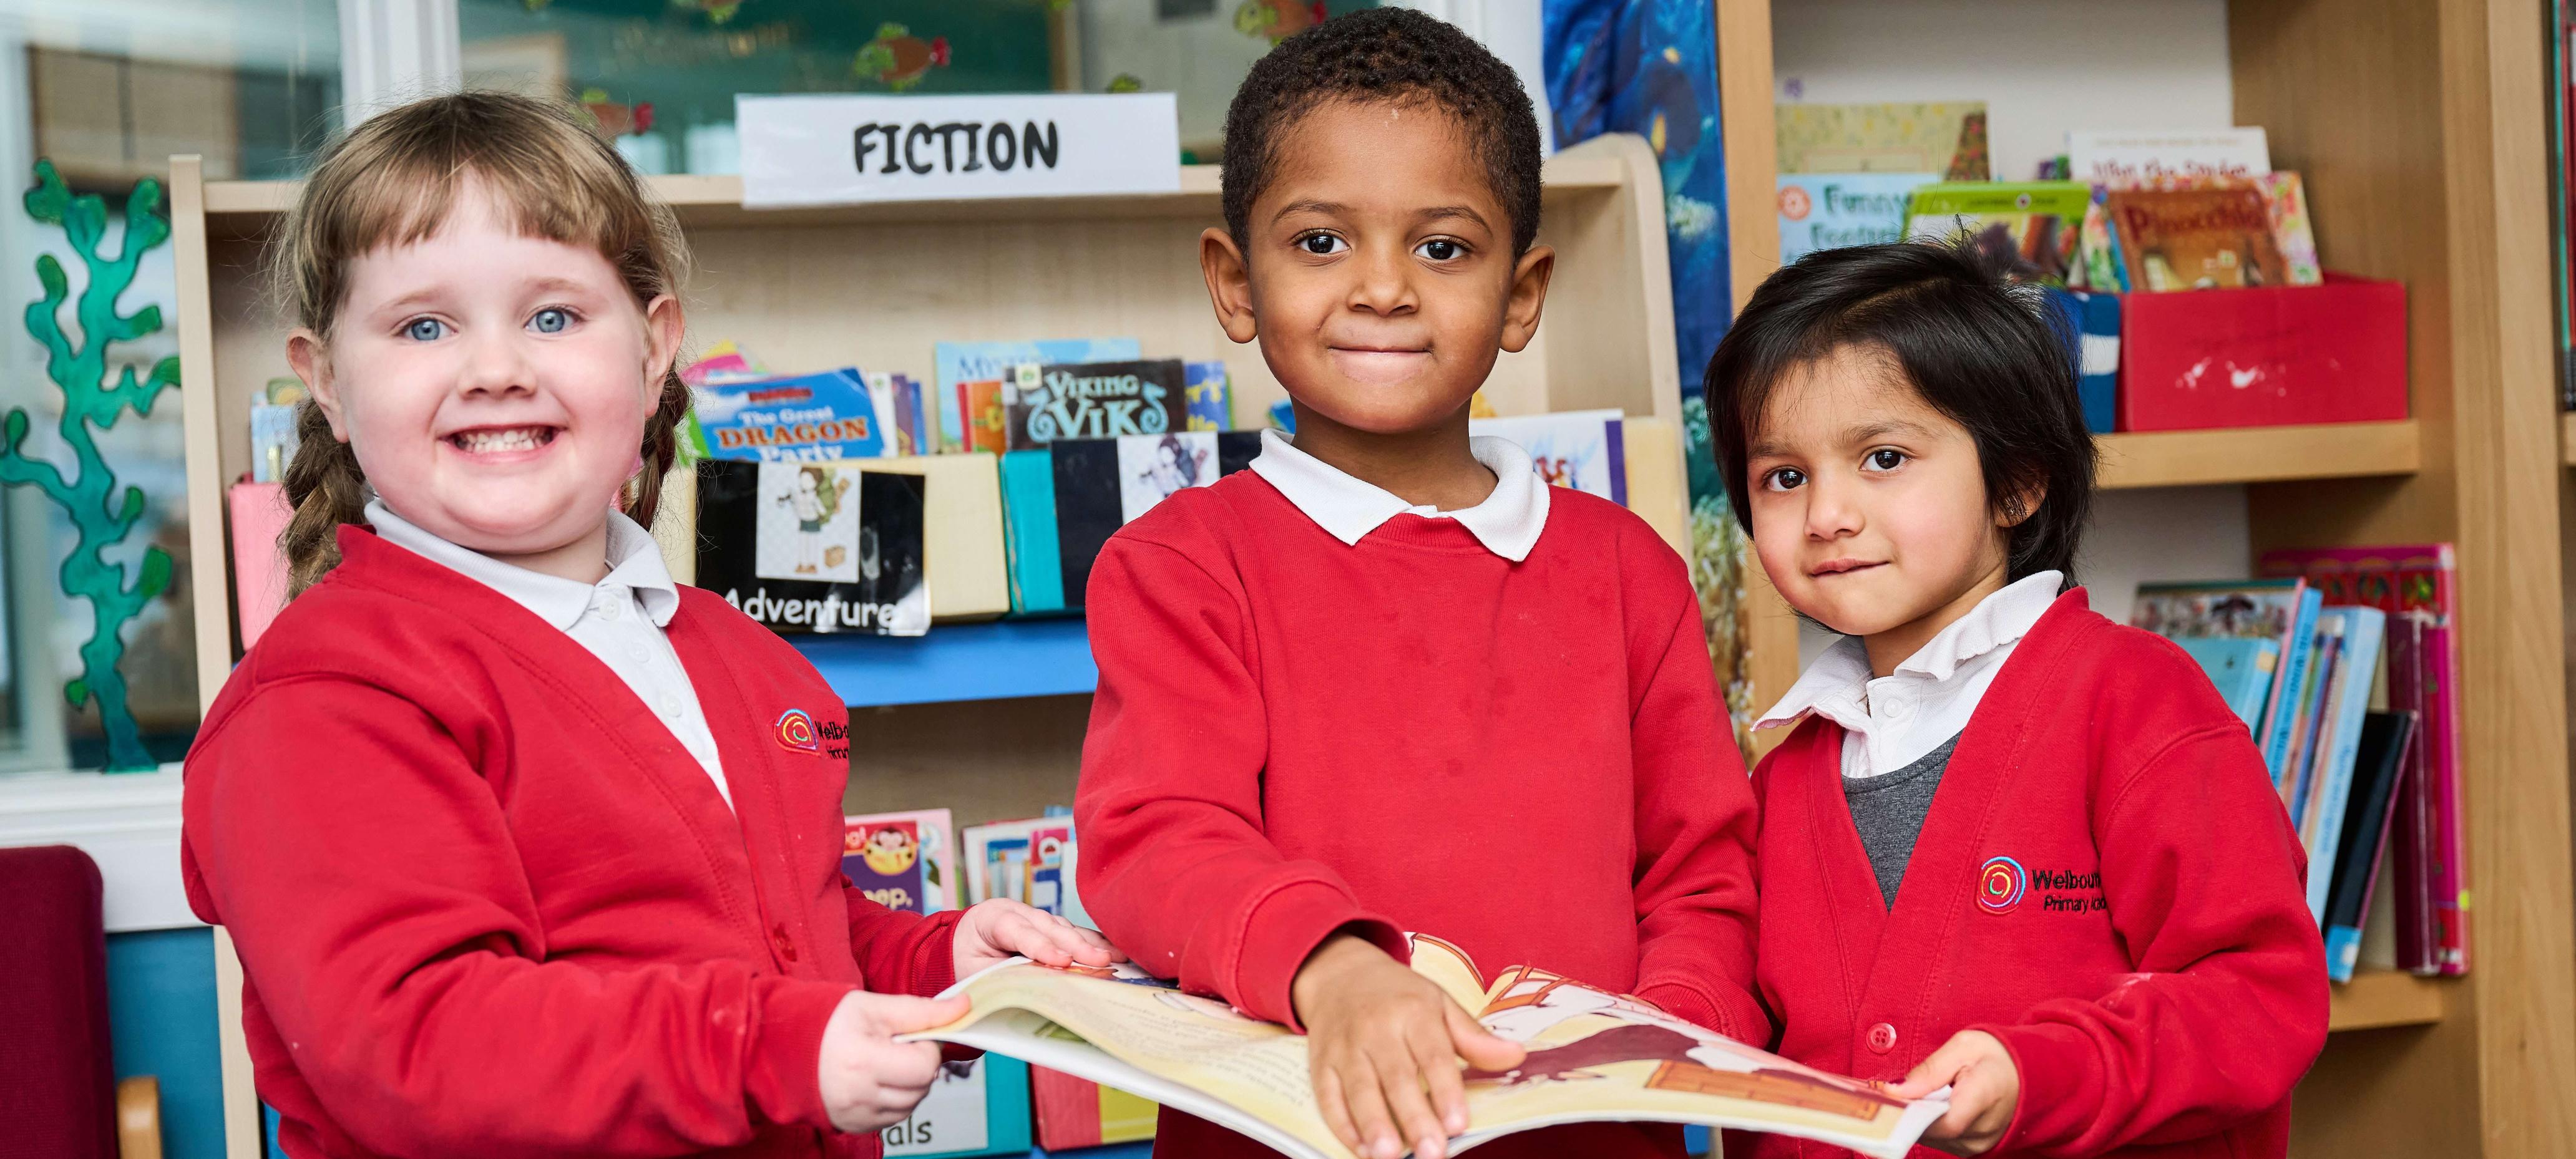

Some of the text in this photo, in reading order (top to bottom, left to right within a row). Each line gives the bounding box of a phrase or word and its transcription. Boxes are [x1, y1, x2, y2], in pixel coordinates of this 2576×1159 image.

[854, 120, 1058, 174] FICTION
[1045, 371, 1139, 397] VIKING
[716, 416, 869, 448] DRAGON
[756, 444, 842, 462] Party
[724, 587, 896, 628] Adventure
[2043, 895, 2089, 914] Primary
[886, 1114, 932, 1146] als
